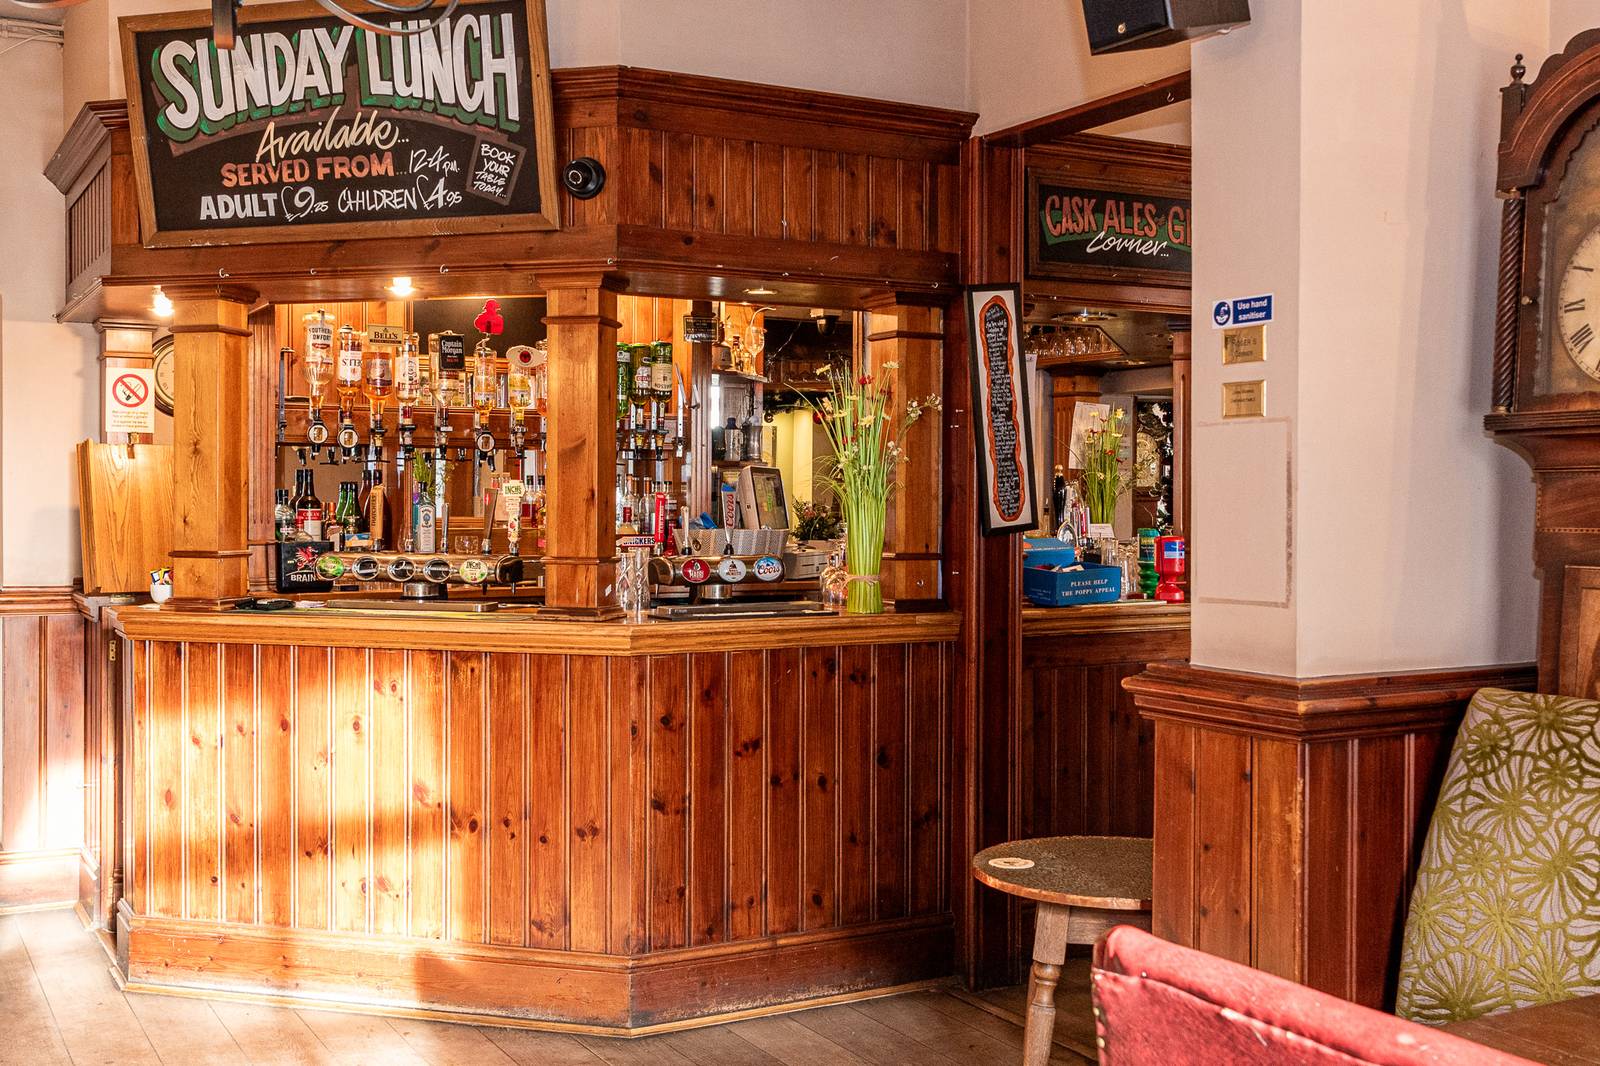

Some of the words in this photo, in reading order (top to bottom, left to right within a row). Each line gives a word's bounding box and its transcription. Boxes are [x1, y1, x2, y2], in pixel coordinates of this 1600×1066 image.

[158, 25, 354, 130] SUNDAY
[366, 12, 520, 122] LUNCH
[480, 144, 516, 165] BOOK
[221, 158, 310, 188] SERVED
[483, 158, 510, 177] YOUR
[475, 171, 505, 186] TABLE
[200, 192, 278, 221] ADULT
[337, 186, 417, 212] CHILDREN
[1045, 195, 1098, 237] CASK
[1102, 199, 1157, 238] ALES
[1167, 205, 1192, 247] GI
[1237, 301, 1249, 310] Use
[1251, 299, 1268, 308] hand
[1238, 311, 1266, 321] sanitiser
[374, 331, 398, 340] BELL'S
[441, 340, 462, 349] Captain
[441, 347, 463, 355] Morgan
[725, 493, 735, 527] Coors
[757, 563, 780, 575] Coors
[1093, 578, 1108, 586] HELP
